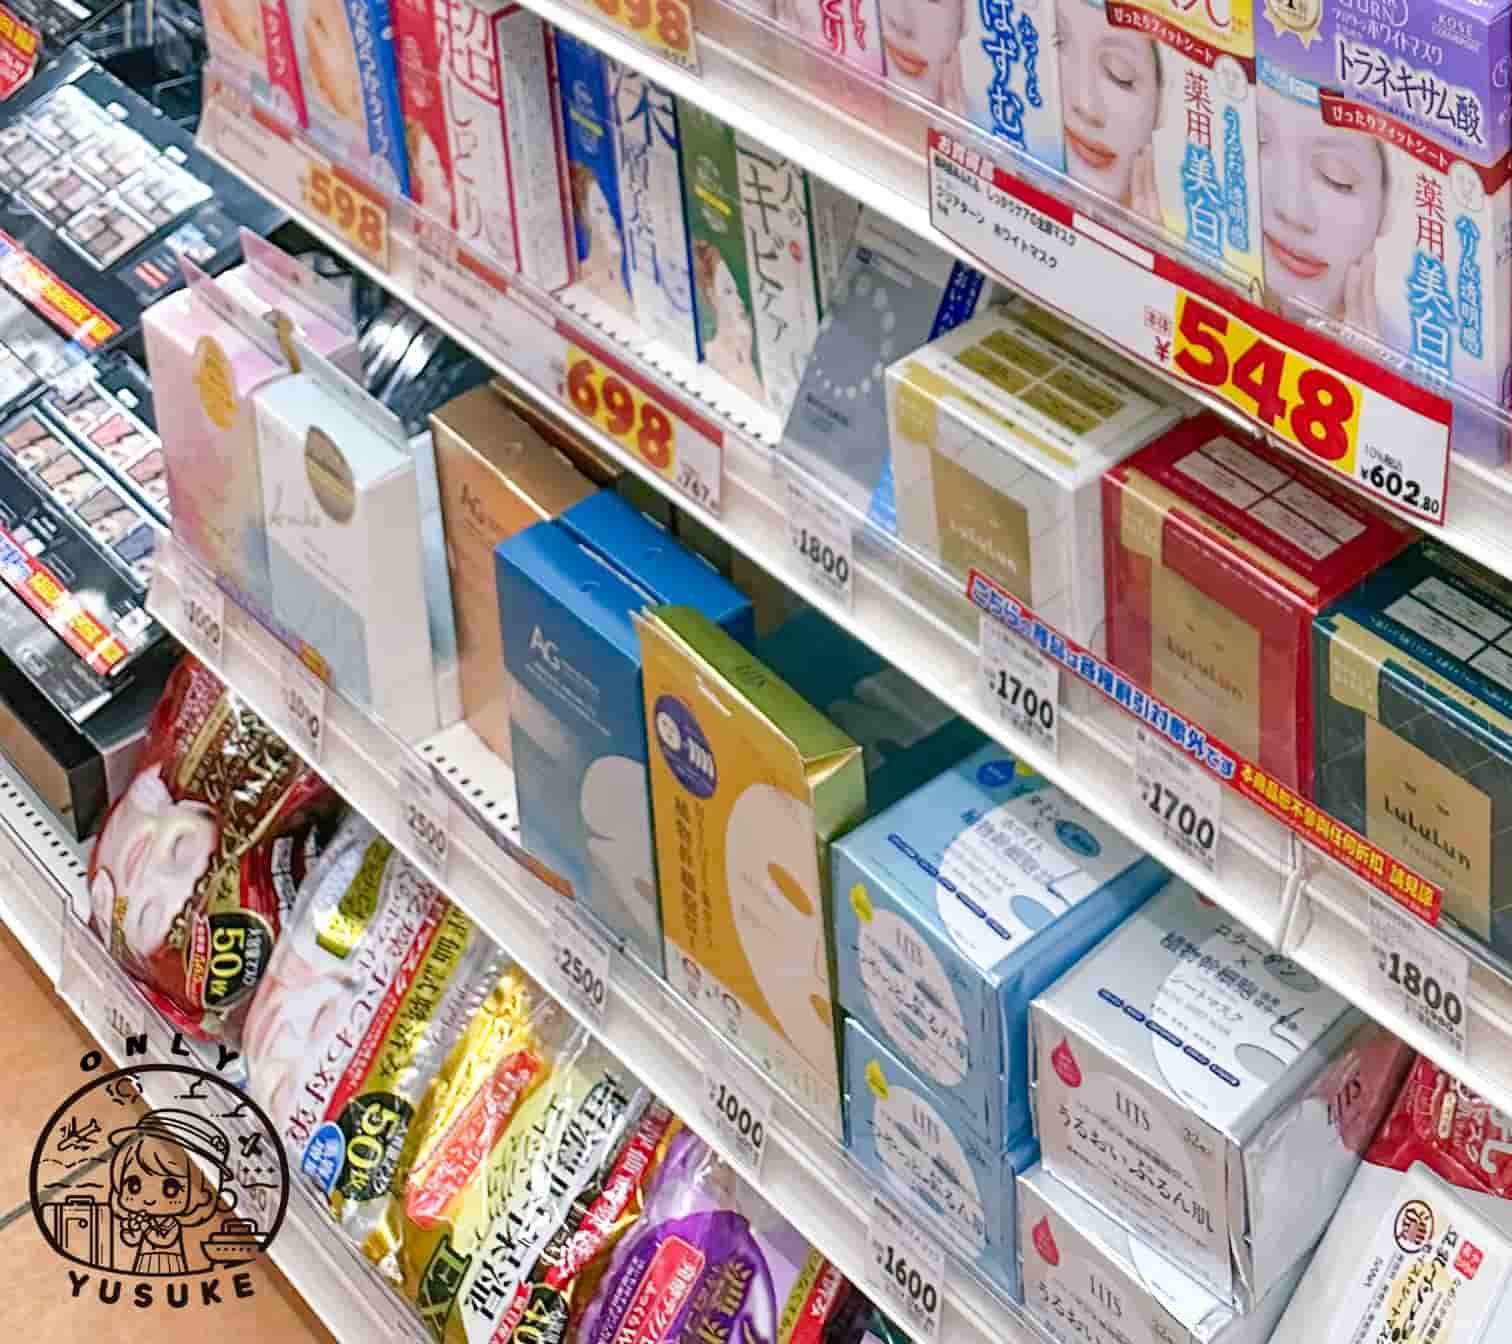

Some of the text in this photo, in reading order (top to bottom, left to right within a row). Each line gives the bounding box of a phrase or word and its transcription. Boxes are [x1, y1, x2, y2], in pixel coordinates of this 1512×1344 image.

[1337, 40, 1484, 146] トラネキサム酸
[565, 365, 674, 471] 698
[1172, 300, 1360, 463] 548
